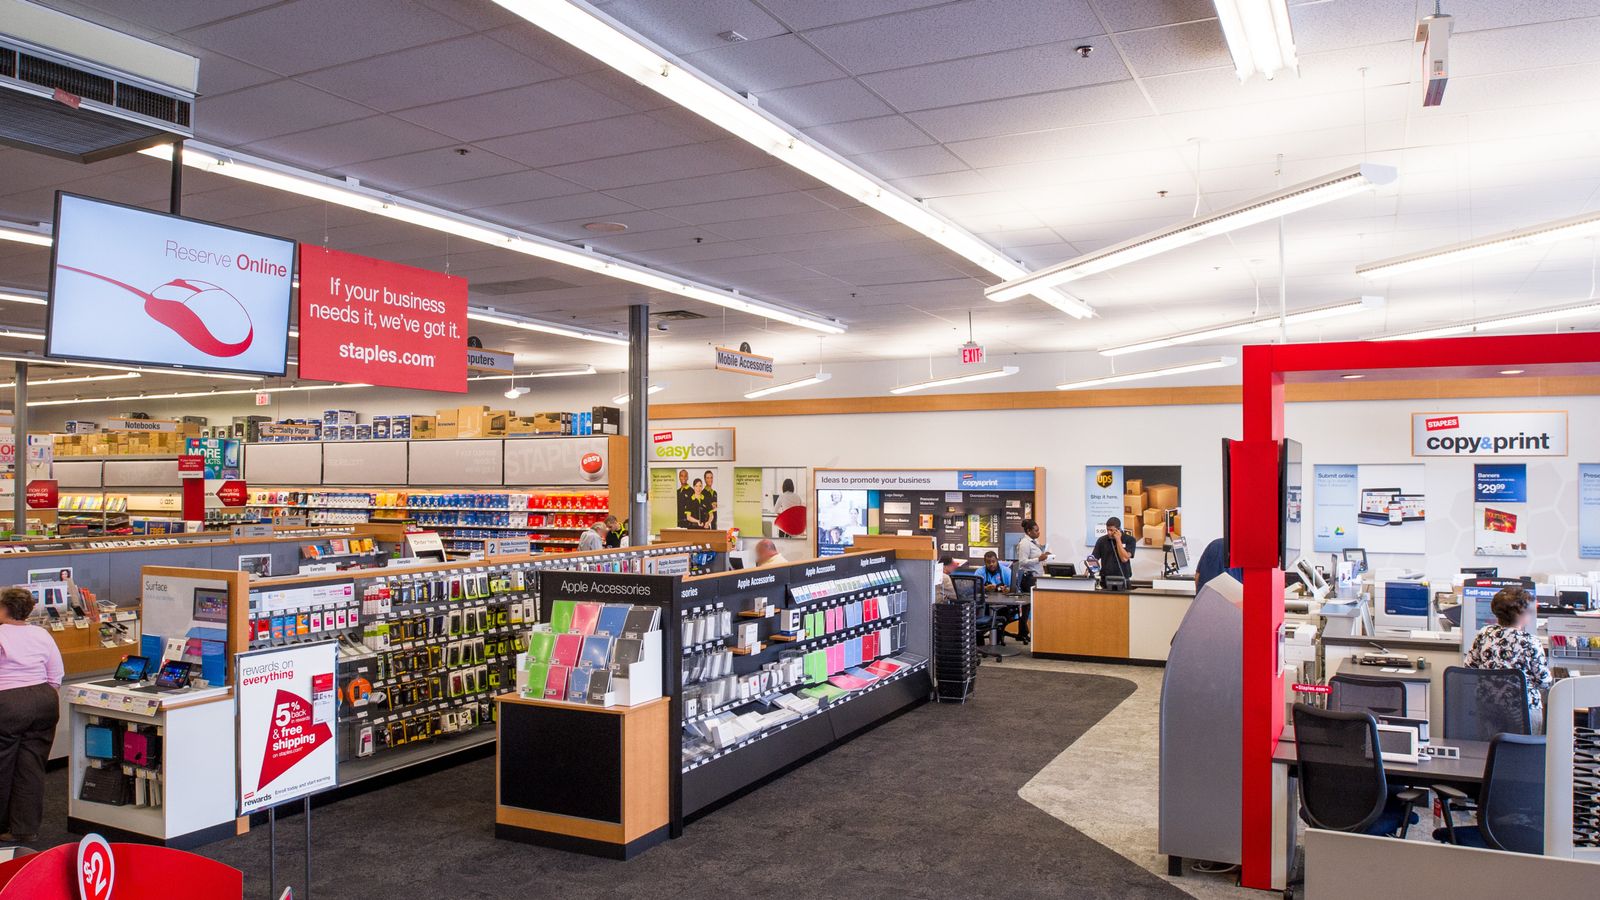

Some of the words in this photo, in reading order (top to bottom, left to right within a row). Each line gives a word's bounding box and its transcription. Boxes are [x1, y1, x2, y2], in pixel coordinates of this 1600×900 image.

[165, 240, 232, 268] Reserve
[236, 253, 288, 278] Online
[330, 277, 341, 296] If
[344, 283, 380, 302] your
[383, 287, 446, 314] business
[309, 303, 359, 324] needs
[364, 307, 378, 329] it,
[379, 313, 420, 333] we've
[423, 322, 446, 339] got
[448, 322, 461, 339] it.
[339, 342, 435, 368] staples.com
[717, 351, 739, 368] Mobile
[739, 355, 773, 373] Accessories
[962, 348, 981, 363] EXIT
[125, 421, 161, 430] Notebooks
[1427, 418, 1458, 428] STAPLES
[294, 427, 310, 436] Paper
[1426, 432, 1550, 453] copy&print
[656, 442, 724, 460] easytech
[582, 454, 600, 466] easy
[850, 477, 880, 486] promote
[881, 478, 897, 486] your
[1097, 475, 1112, 487] ups
[489, 543, 496, 554] 2
[145, 580, 168, 592] Surface
[561, 580, 589, 594] Apple
[590, 581, 651, 596] Accessories
[737, 577, 750, 588] Apple
[750, 574, 775, 586] Accessories
[243, 661, 279, 677] rewards
[281, 660, 294, 668] on
[243, 670, 294, 686] everything
[291, 709, 307, 718] back
[272, 729, 280, 739] &
[281, 726, 302, 737] free
[272, 733, 315, 751] shipping
[244, 794, 272, 807] rewards
[83, 851, 108, 897] $2
